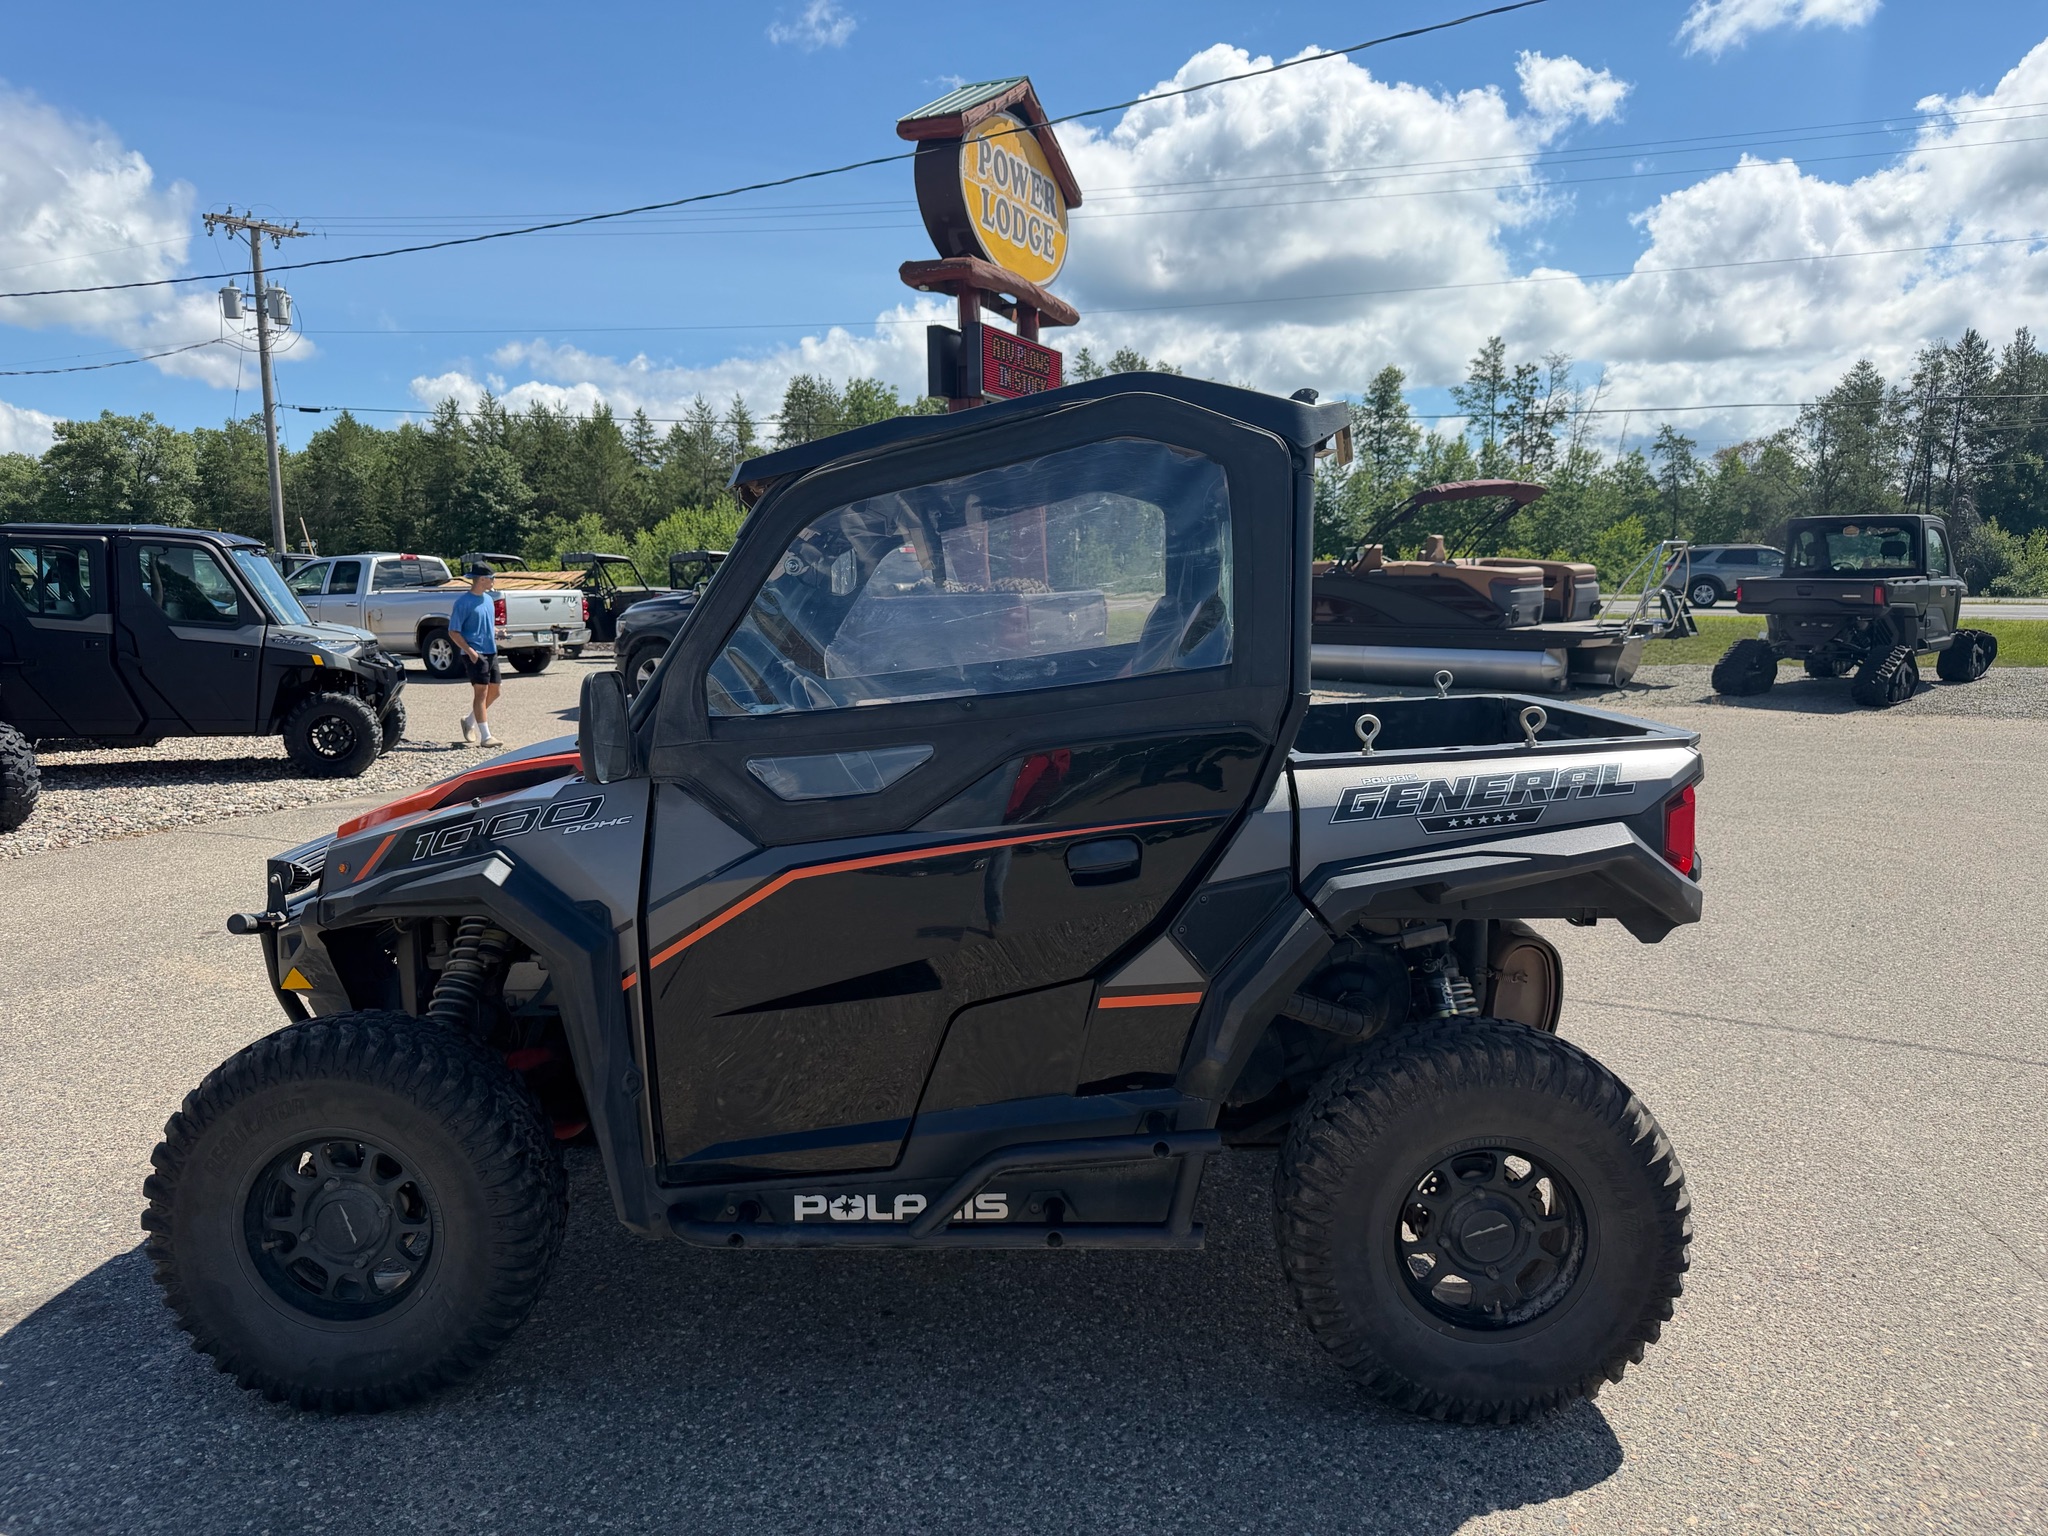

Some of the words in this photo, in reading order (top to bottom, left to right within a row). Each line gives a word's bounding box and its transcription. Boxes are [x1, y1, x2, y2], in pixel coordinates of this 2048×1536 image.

[977, 134, 1057, 220] POWER
[980, 188, 1055, 264] LODGE
[999, 365, 1012, 389] IN
[1017, 345, 1050, 374] PLOWS
[1330, 763, 1636, 824] GENERAL
[1361, 773, 1419, 785] POLARIS
[412, 795, 605, 861] 1000
[563, 815, 633, 835] DOHC
[794, 1193, 1008, 1221] POLAIS
